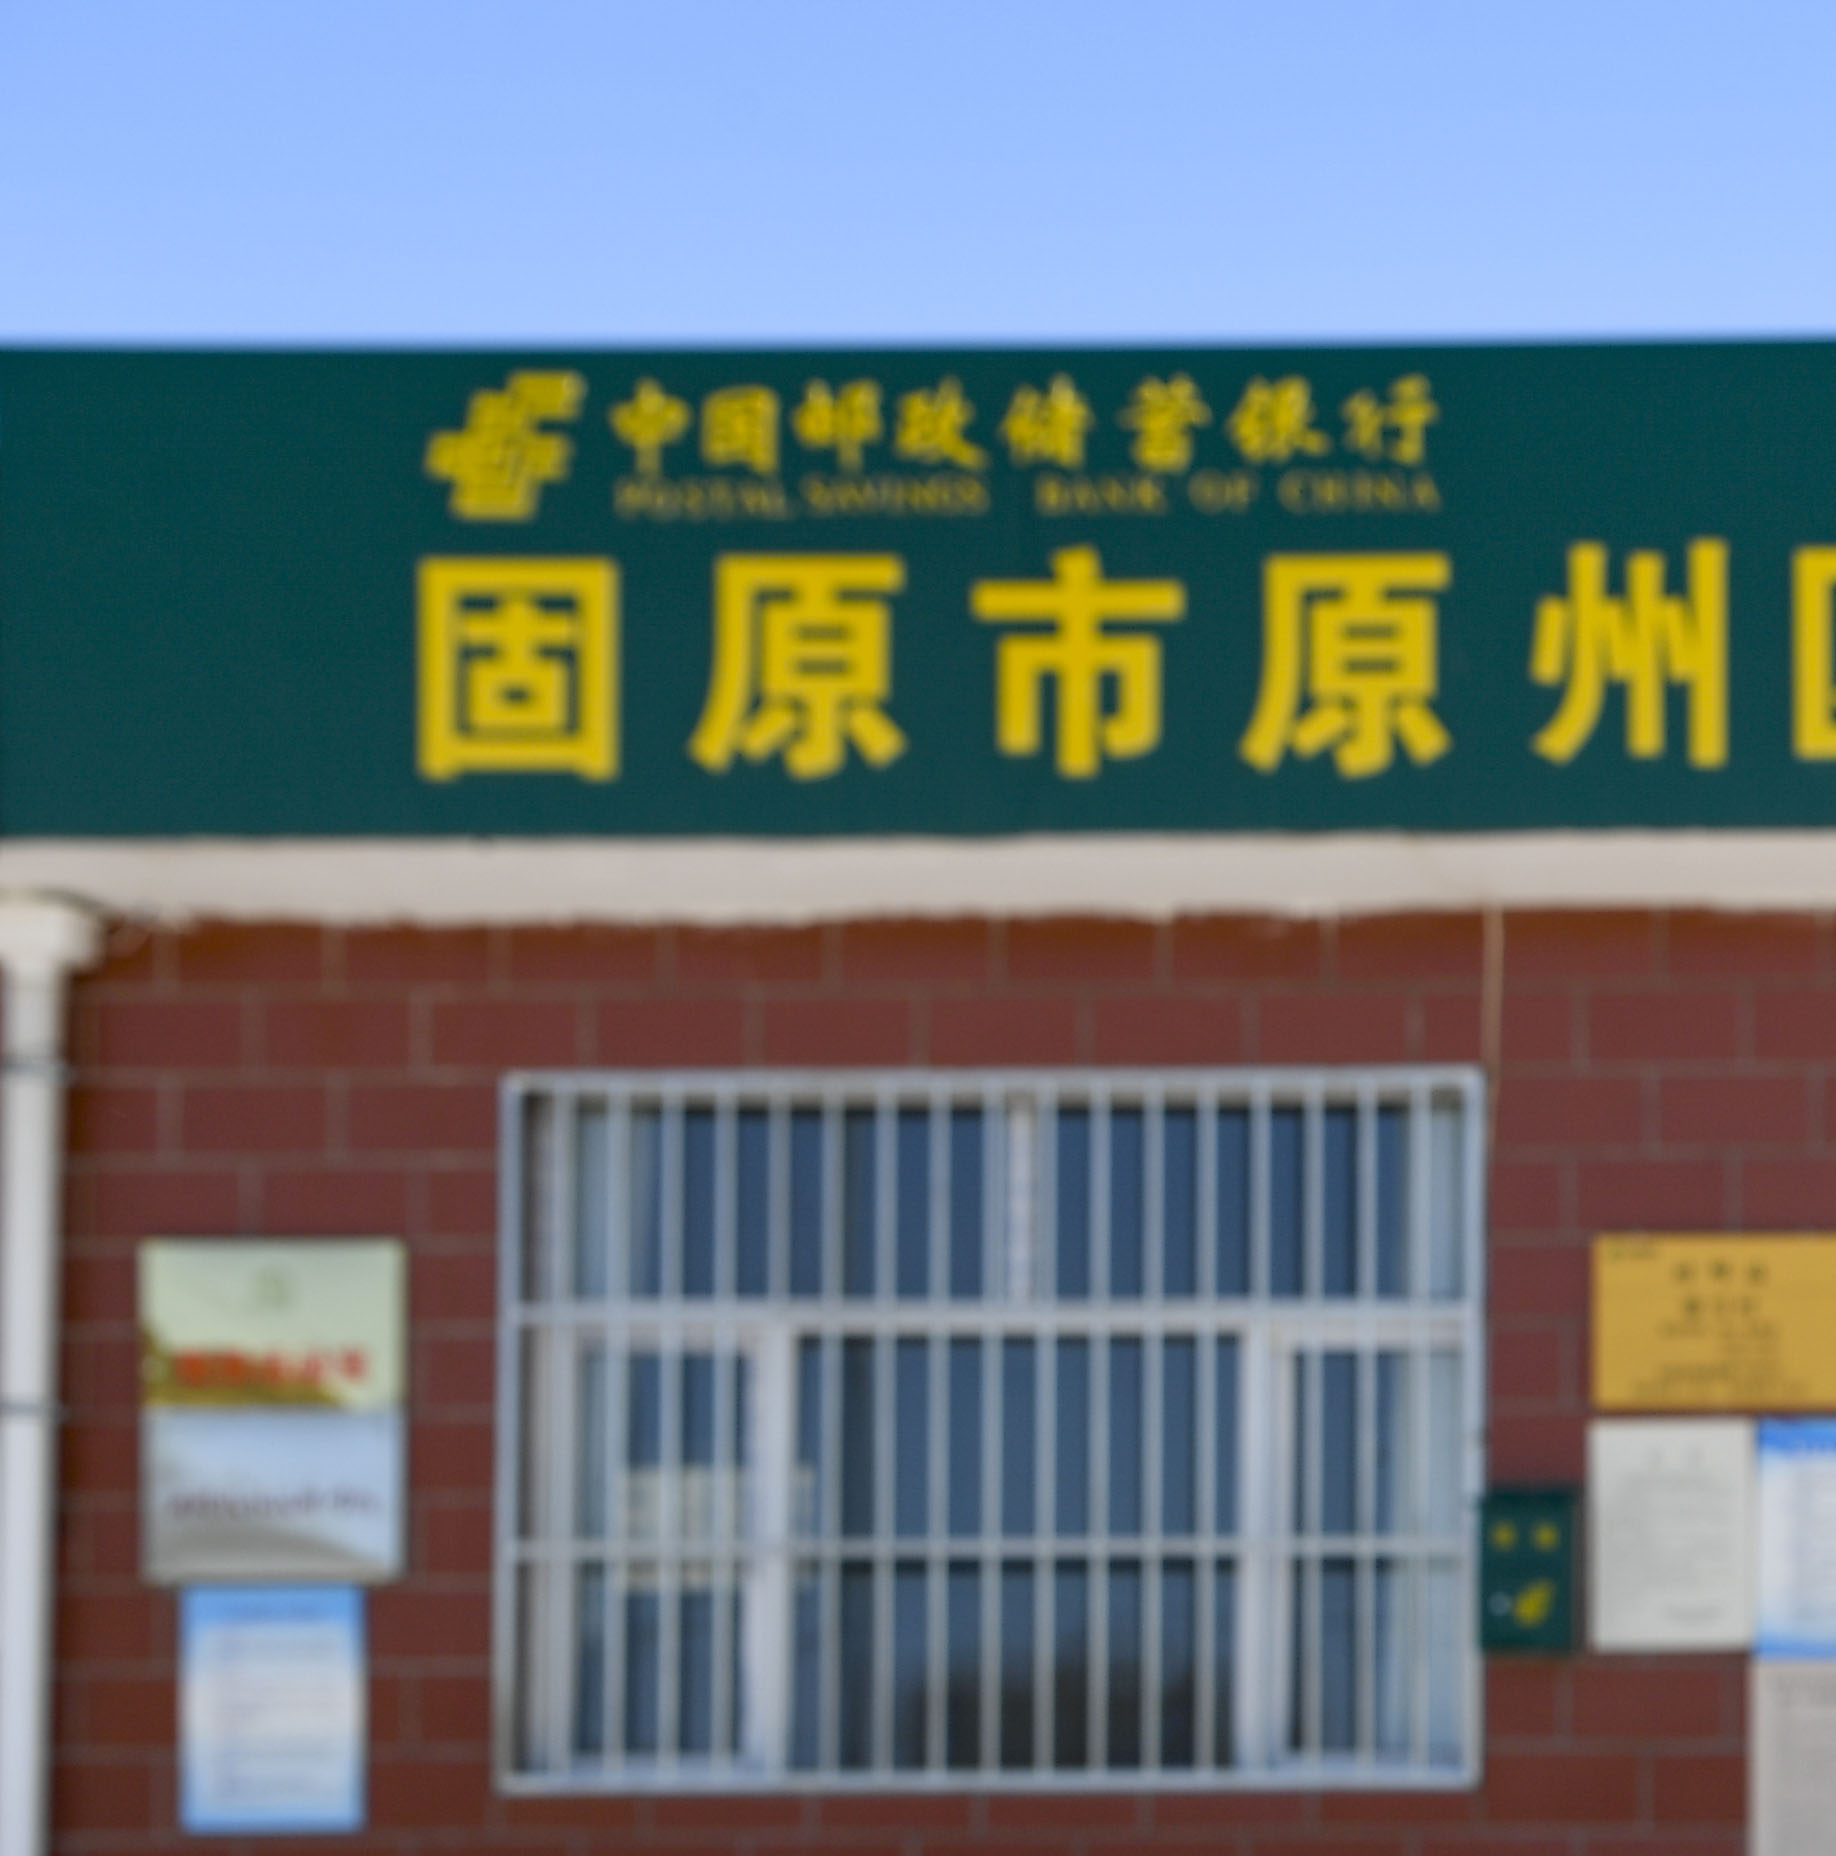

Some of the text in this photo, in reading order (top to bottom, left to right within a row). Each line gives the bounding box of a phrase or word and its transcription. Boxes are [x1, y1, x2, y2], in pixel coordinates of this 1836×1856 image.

[1036, 472, 1163, 513] BANK
[1190, 471, 1253, 511] OF
[1281, 469, 1438, 511] CHINA
